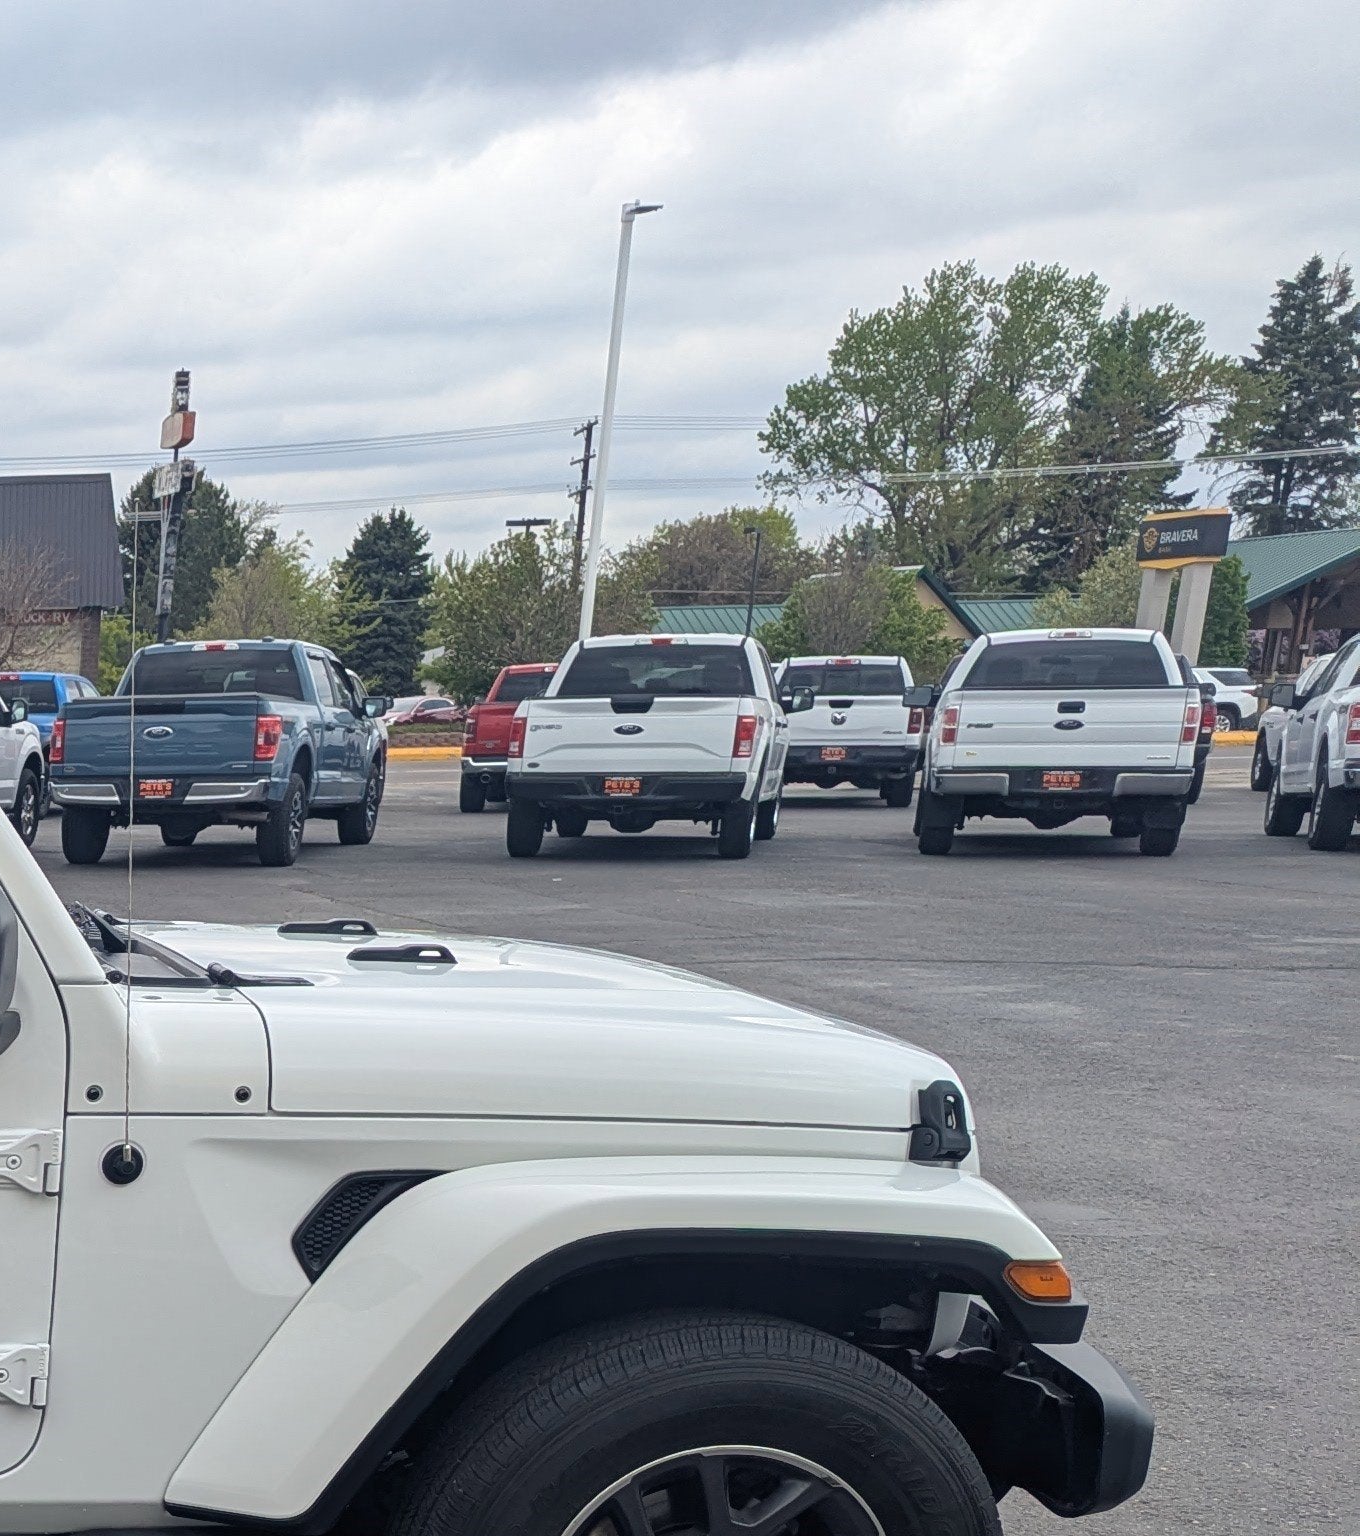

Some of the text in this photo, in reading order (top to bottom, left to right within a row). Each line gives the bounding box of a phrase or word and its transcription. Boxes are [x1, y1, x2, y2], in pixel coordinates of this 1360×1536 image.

[1160, 528, 1199, 544] BRAVERA
[1043, 774, 1080, 783] PETE'S
[140, 782, 172, 791] PETE'S
[604, 780, 640, 789] PETE'S
